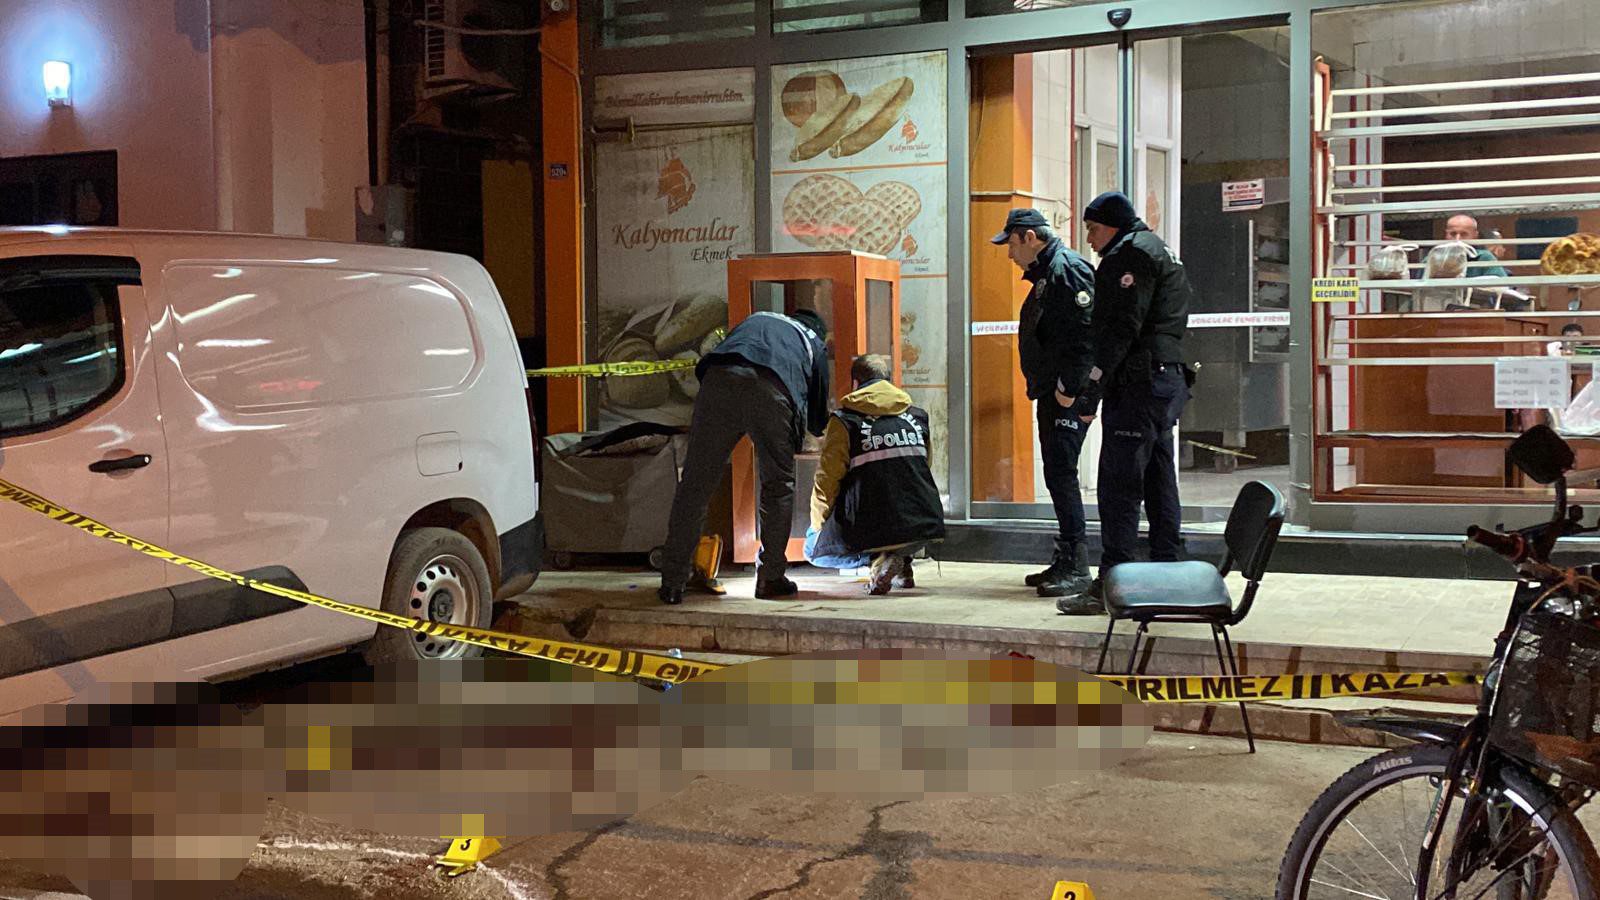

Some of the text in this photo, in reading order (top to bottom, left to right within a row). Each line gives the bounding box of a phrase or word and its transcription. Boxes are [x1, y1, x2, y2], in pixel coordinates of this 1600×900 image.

[612, 217, 739, 252] Kalyoncular
[691, 245, 733, 263] Ekmek
[1331, 674, 1450, 693] KAZA
